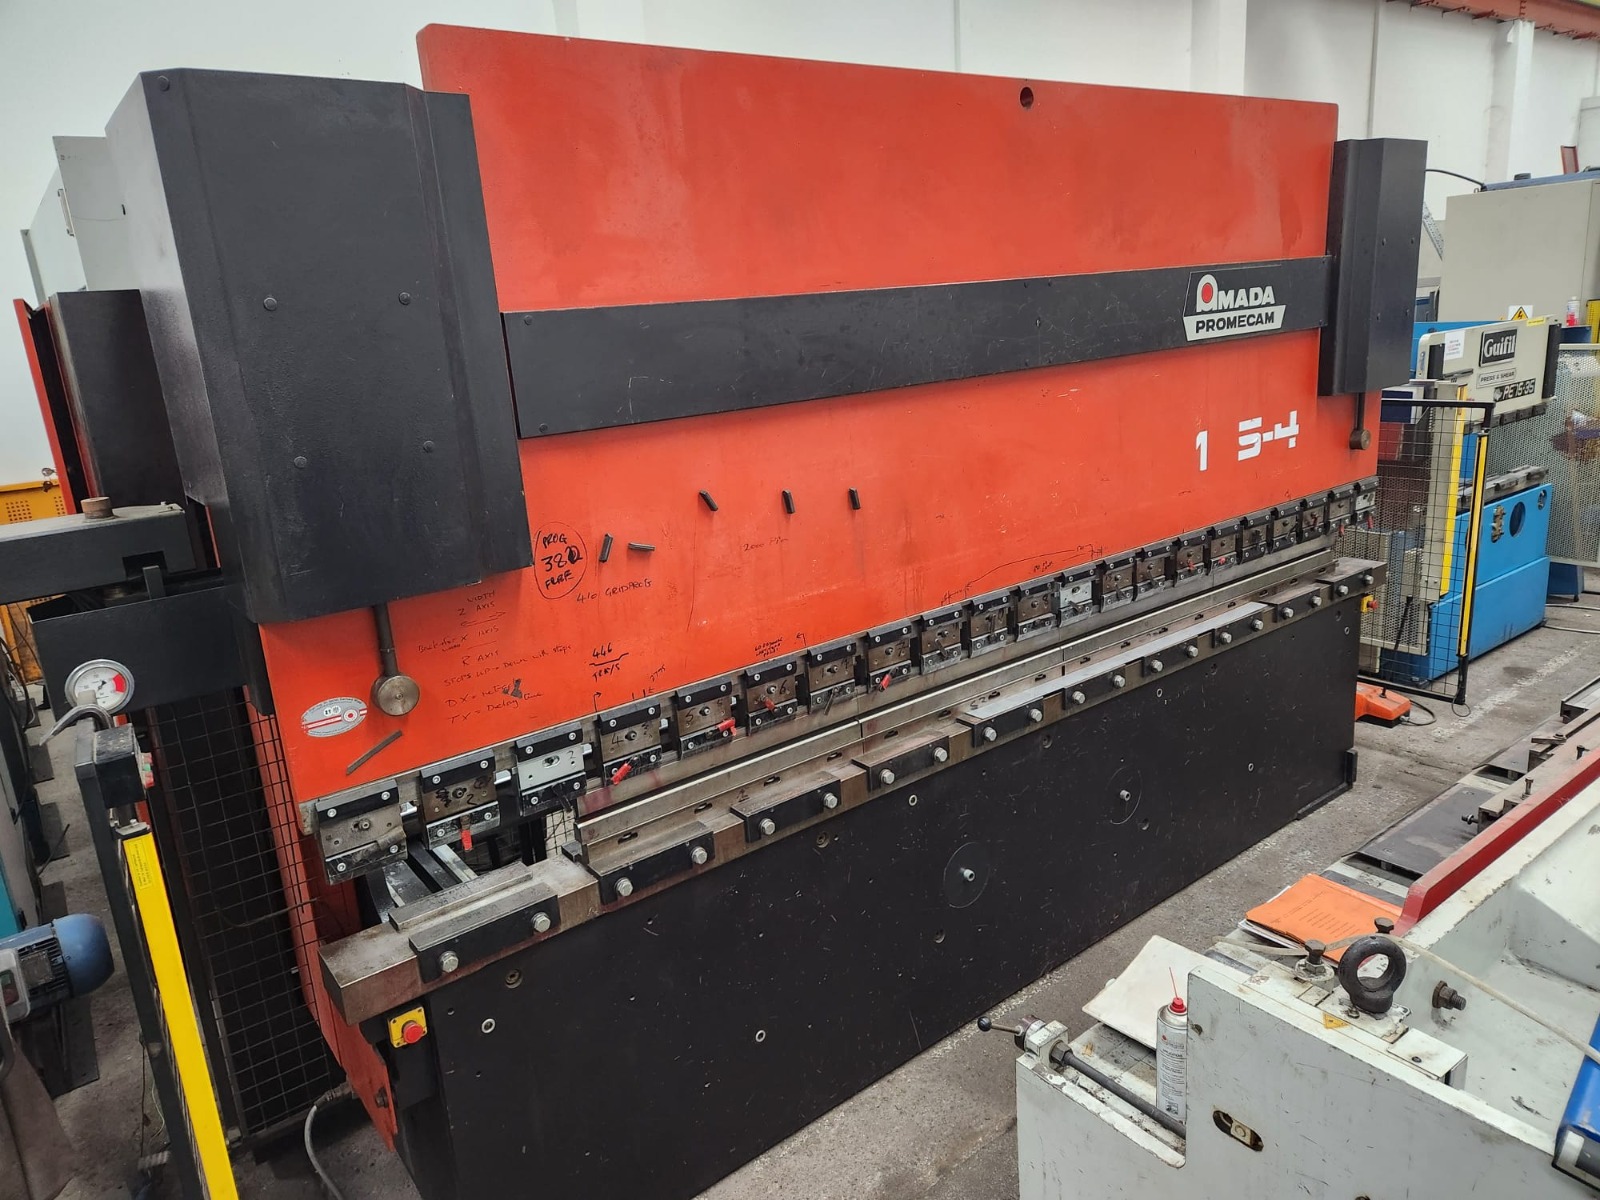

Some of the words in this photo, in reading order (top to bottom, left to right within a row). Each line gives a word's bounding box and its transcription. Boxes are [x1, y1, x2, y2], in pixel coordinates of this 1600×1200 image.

[1196, 274, 1275, 312] AMADA
[1195, 311, 1275, 334] PROMECAM
[1484, 334, 1516, 358] Guifil
[1480, 375, 1495, 383] PRESS
[1500, 371, 1515, 379] SHEAR
[542, 532, 567, 549] PROG
[476, 601, 496, 612] AXIS
[779, 679, 787, 695] 6
[685, 708, 695, 723] 5
[611, 733, 624, 746] 4
[467, 793, 477, 806] 2
